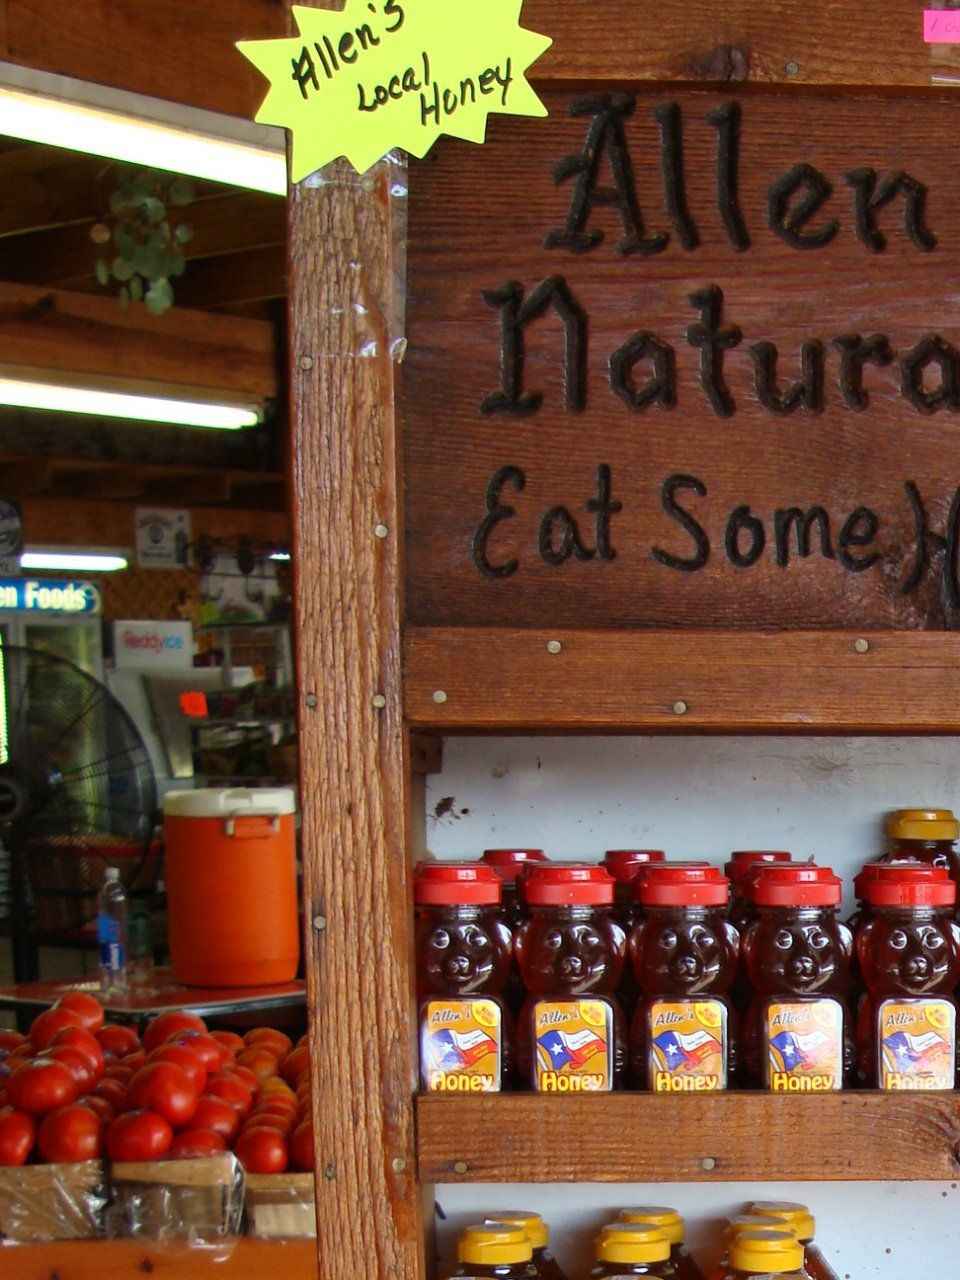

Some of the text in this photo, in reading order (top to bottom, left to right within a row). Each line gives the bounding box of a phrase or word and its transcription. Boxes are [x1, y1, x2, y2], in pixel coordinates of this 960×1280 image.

[292, 0, 405, 99] Allen's
[358, 52, 430, 112] Local
[420, 57, 513, 126] Honey
[543, 93, 937, 257] Allen
[472, 464, 622, 579] Eat
[651, 473, 881, 572] Some
[25, 582, 87, 611] Foods
[540, 1006, 578, 1025] Allen's
[656, 1007, 693, 1026] Allen's
[431, 1070, 493, 1092] Honey
[541, 1071, 604, 1092] Honey
[656, 1071, 718, 1092] Honey
[773, 1071, 834, 1091] Honey
[886, 1072, 946, 1090] Honey
